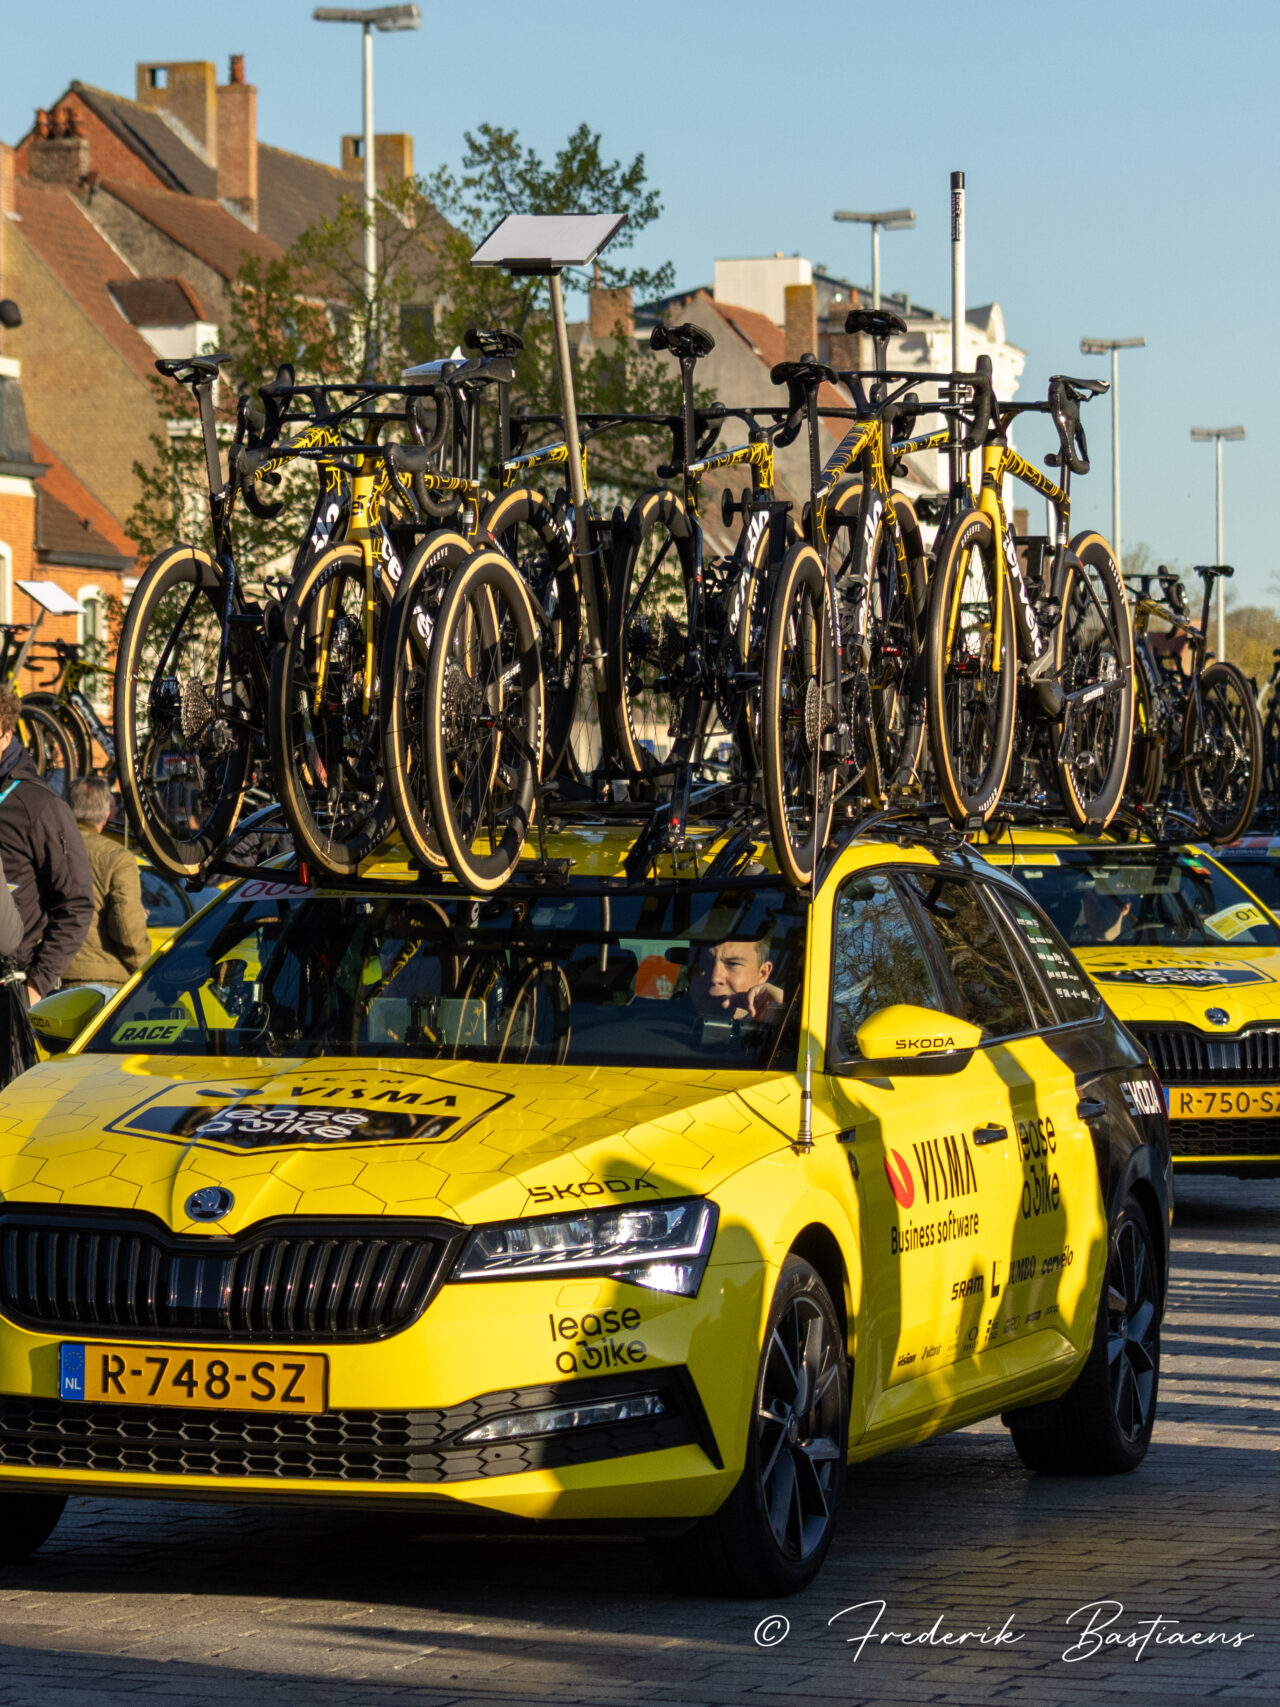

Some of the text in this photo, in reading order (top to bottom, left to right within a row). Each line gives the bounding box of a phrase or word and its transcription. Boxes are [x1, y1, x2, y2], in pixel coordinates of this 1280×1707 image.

[119, 1025, 178, 1042] RACE
[290, 1085, 458, 1108] VISMA
[299, 1076, 405, 1084] TEAM
[1011, 1113, 1058, 1164] lease
[912, 1132, 978, 1205] VISMA
[891, 1209, 980, 1256] Business software
[951, 1274, 984, 1301] SRAM
[548, 1307, 641, 1342] lease
[64, 1353, 307, 1405] NL R-748-SZ
